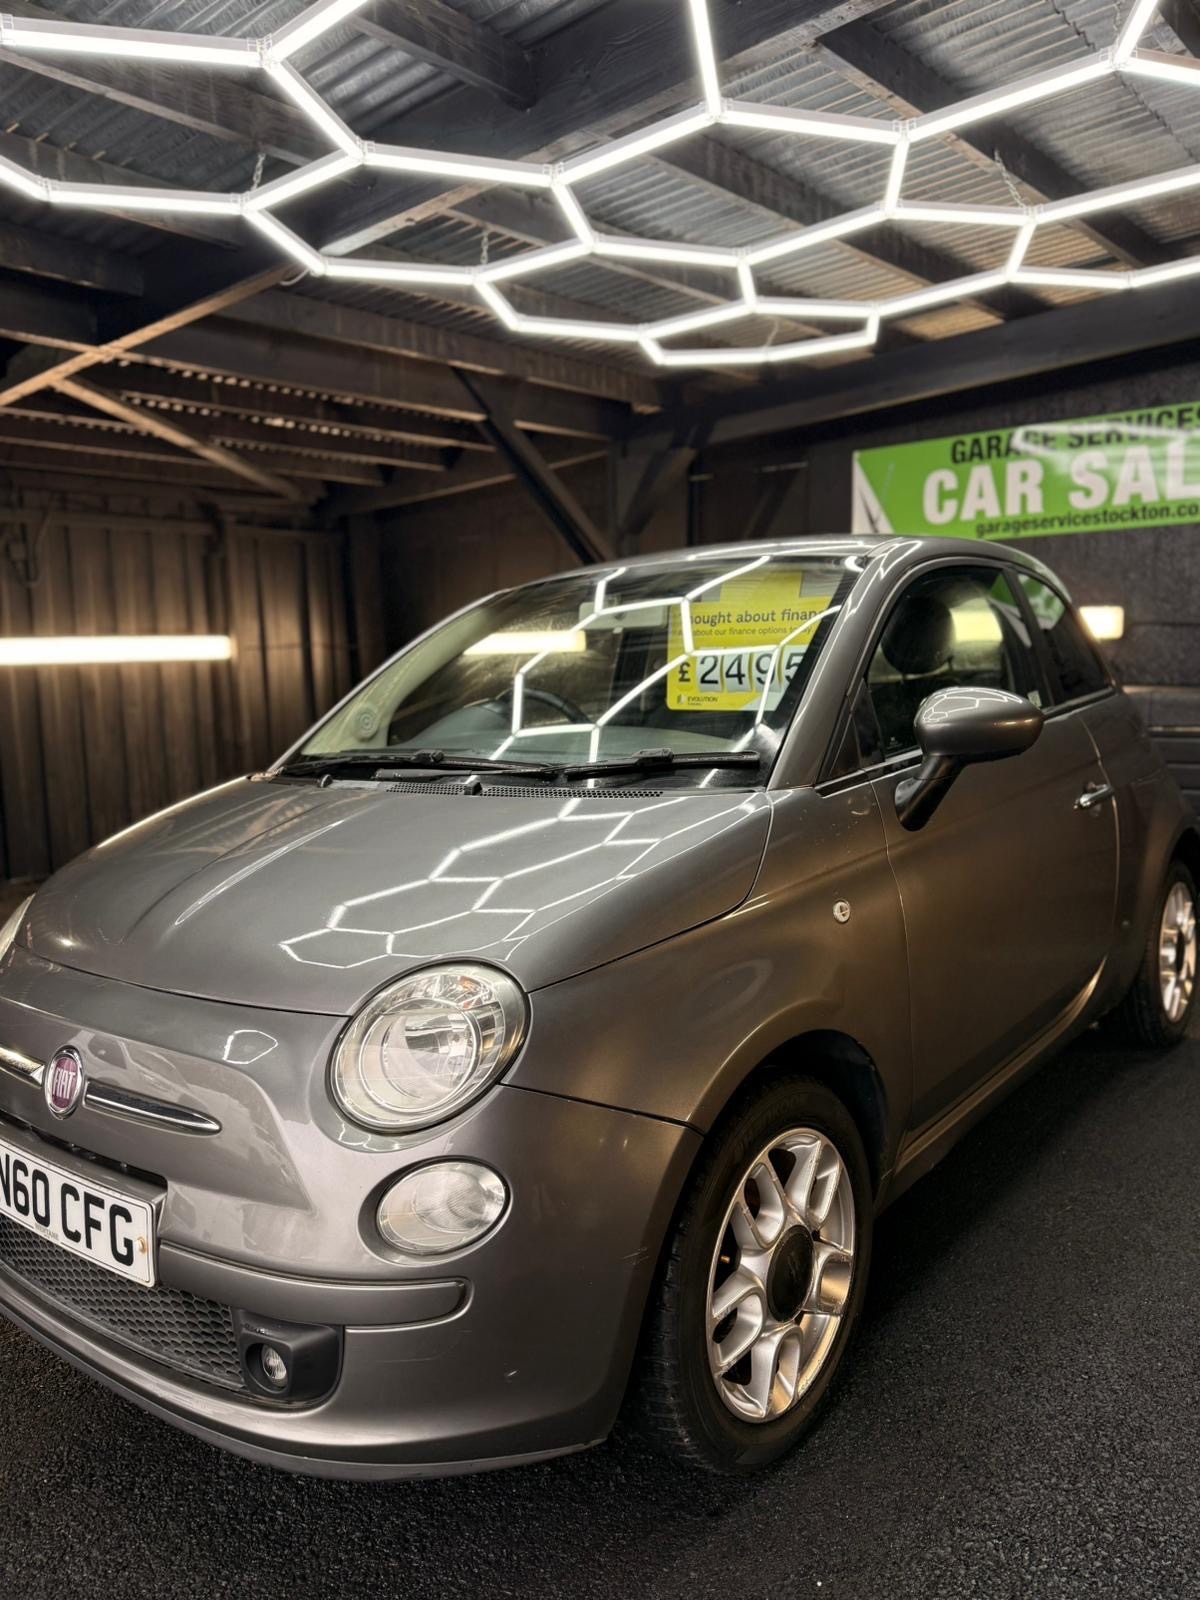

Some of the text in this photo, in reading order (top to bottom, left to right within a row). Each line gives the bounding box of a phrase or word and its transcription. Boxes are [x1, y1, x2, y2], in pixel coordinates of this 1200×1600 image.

[922, 459, 1044, 525] CAR
[729, 626, 757, 635] finance
[758, 625, 787, 636] options
[736, 609, 776, 624] about
[52, 1066, 76, 1099] FIAT
[60, 1182, 134, 1267] CFG
